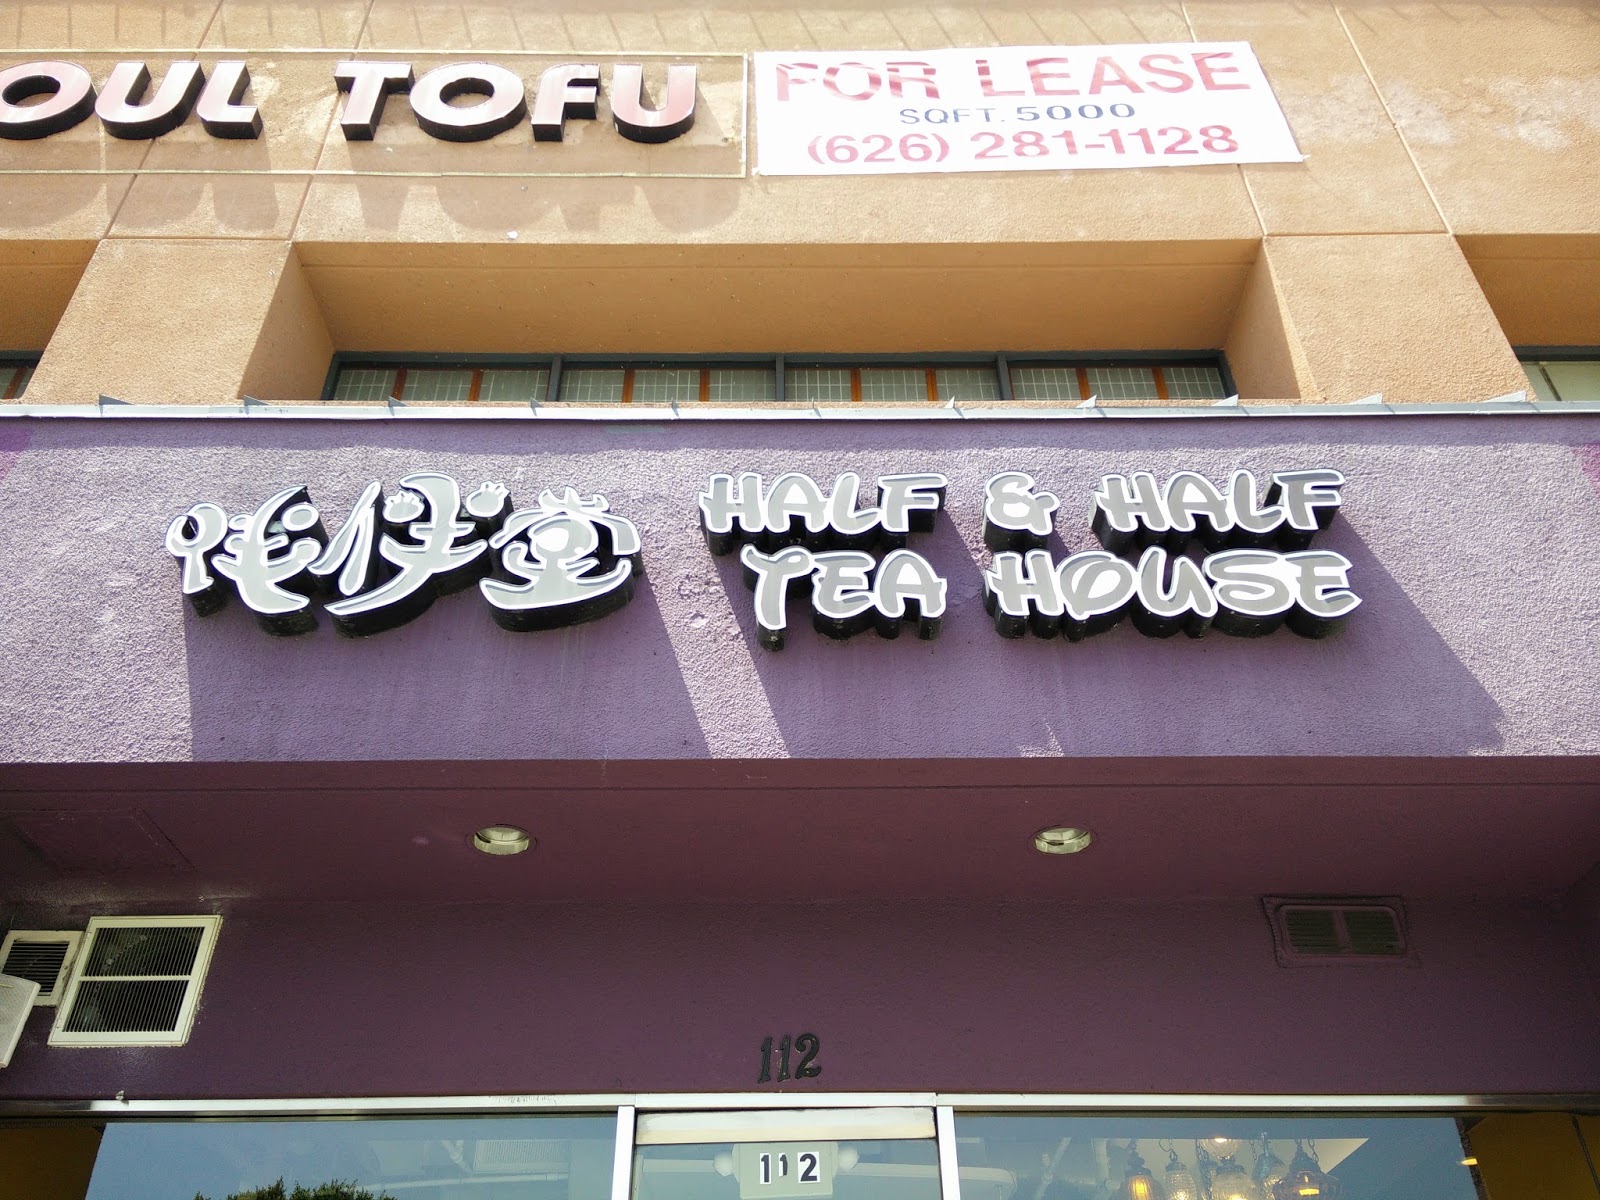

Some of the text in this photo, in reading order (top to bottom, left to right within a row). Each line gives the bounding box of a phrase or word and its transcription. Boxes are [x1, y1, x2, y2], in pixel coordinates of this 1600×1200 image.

[0, 60, 698, 142] OUL TOFU
[776, 52, 1252, 101] FOR LEASE
[1016, 103, 1136, 121] 5000
[807, 125, 1239, 164] (626) 281-1128
[700, 469, 1346, 536] HALF & HALF
[741, 545, 1363, 632] TEA HOUSE
[758, 1033, 822, 1083] 112
[760, 1153, 818, 1183] 112
